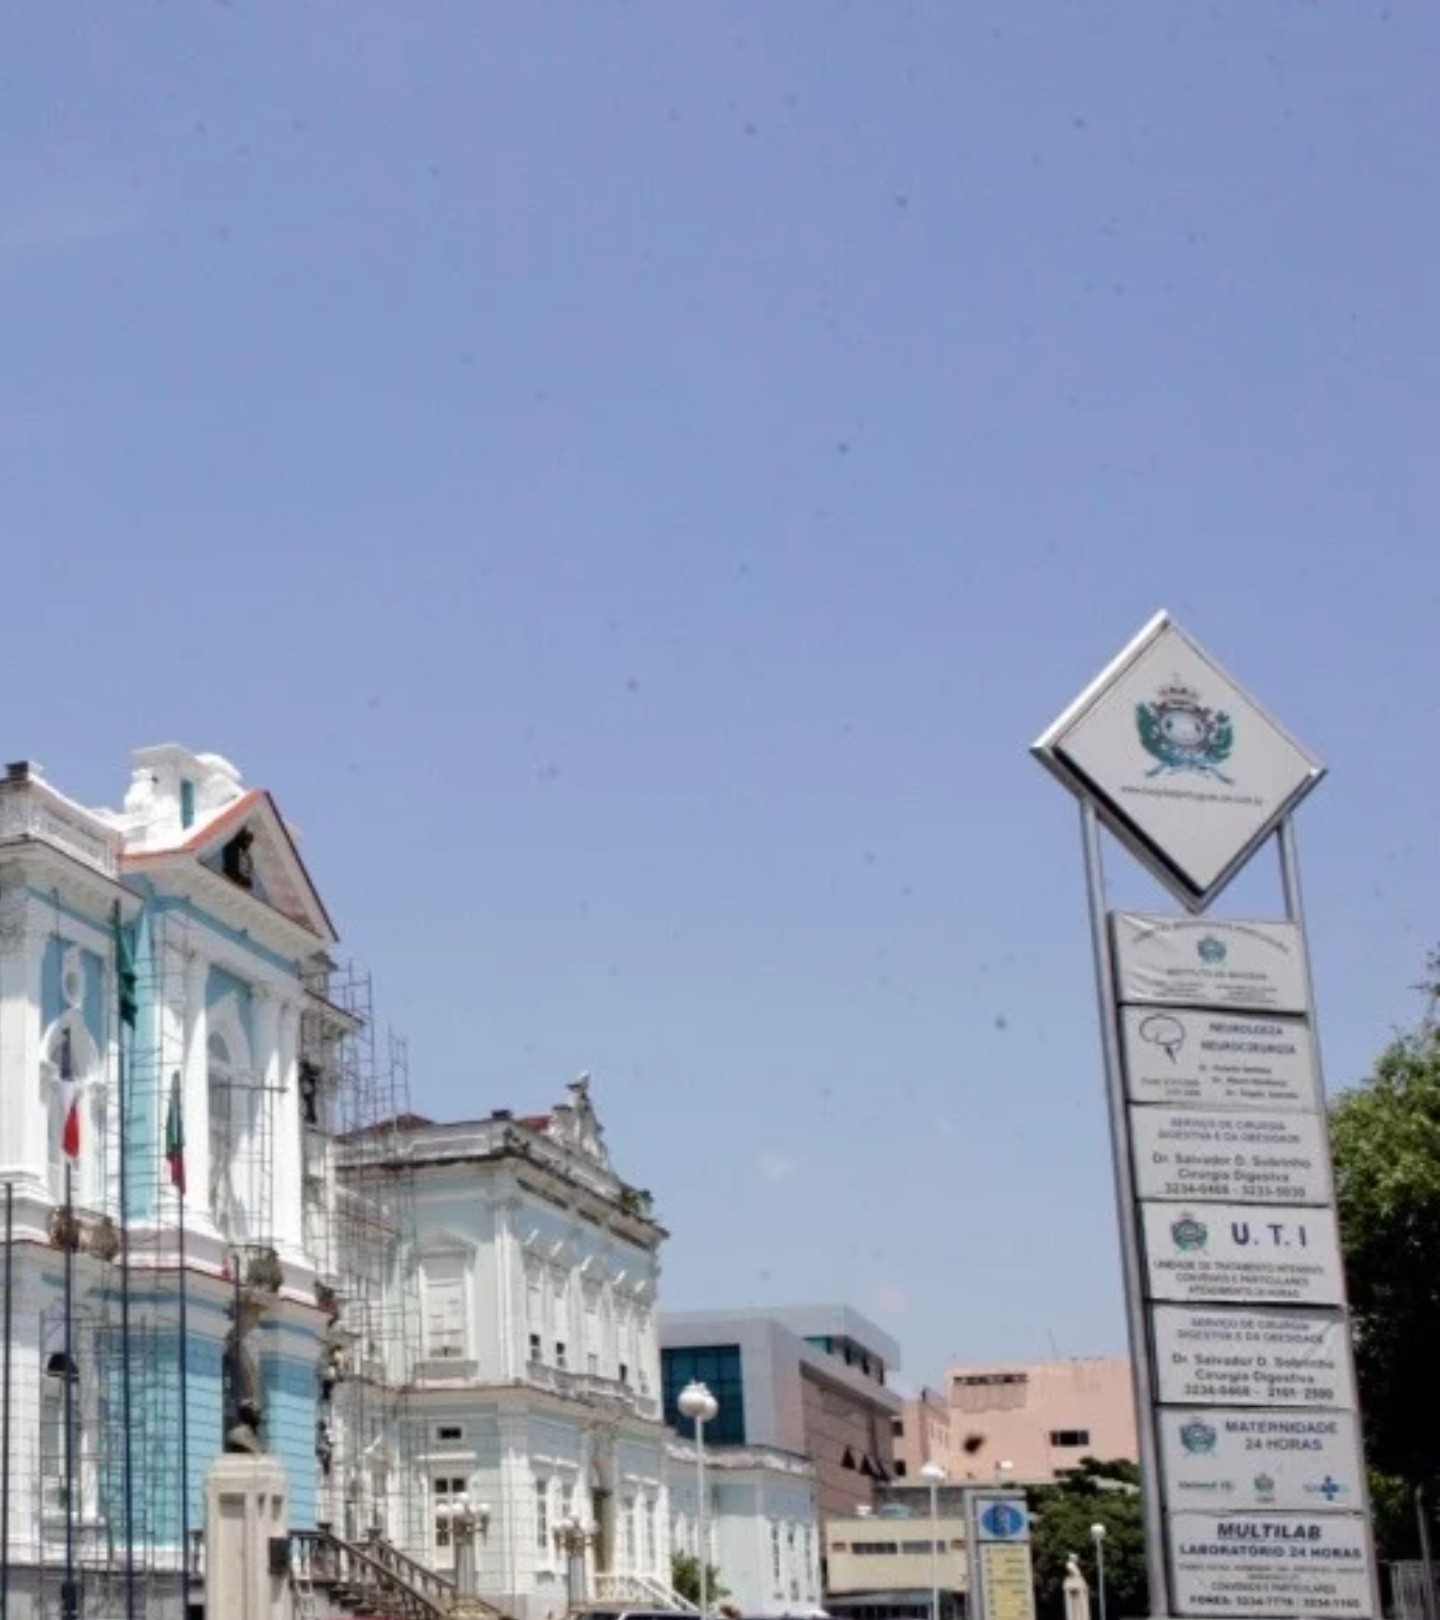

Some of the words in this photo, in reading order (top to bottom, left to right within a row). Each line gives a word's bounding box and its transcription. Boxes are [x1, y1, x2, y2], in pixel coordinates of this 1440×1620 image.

[1175, 1152, 1232, 1166] Salvador
[1194, 1353, 1253, 1367] Salvador
[1225, 1420, 1338, 1435] MATERNIDADE
[1245, 1438, 1262, 1450] 24
[1266, 1438, 1322, 1451] HORAS
[1217, 1522, 1322, 1541] MULTILAB
[1289, 1546, 1306, 1558] 24
[1310, 1547, 1362, 1559] HORAS
